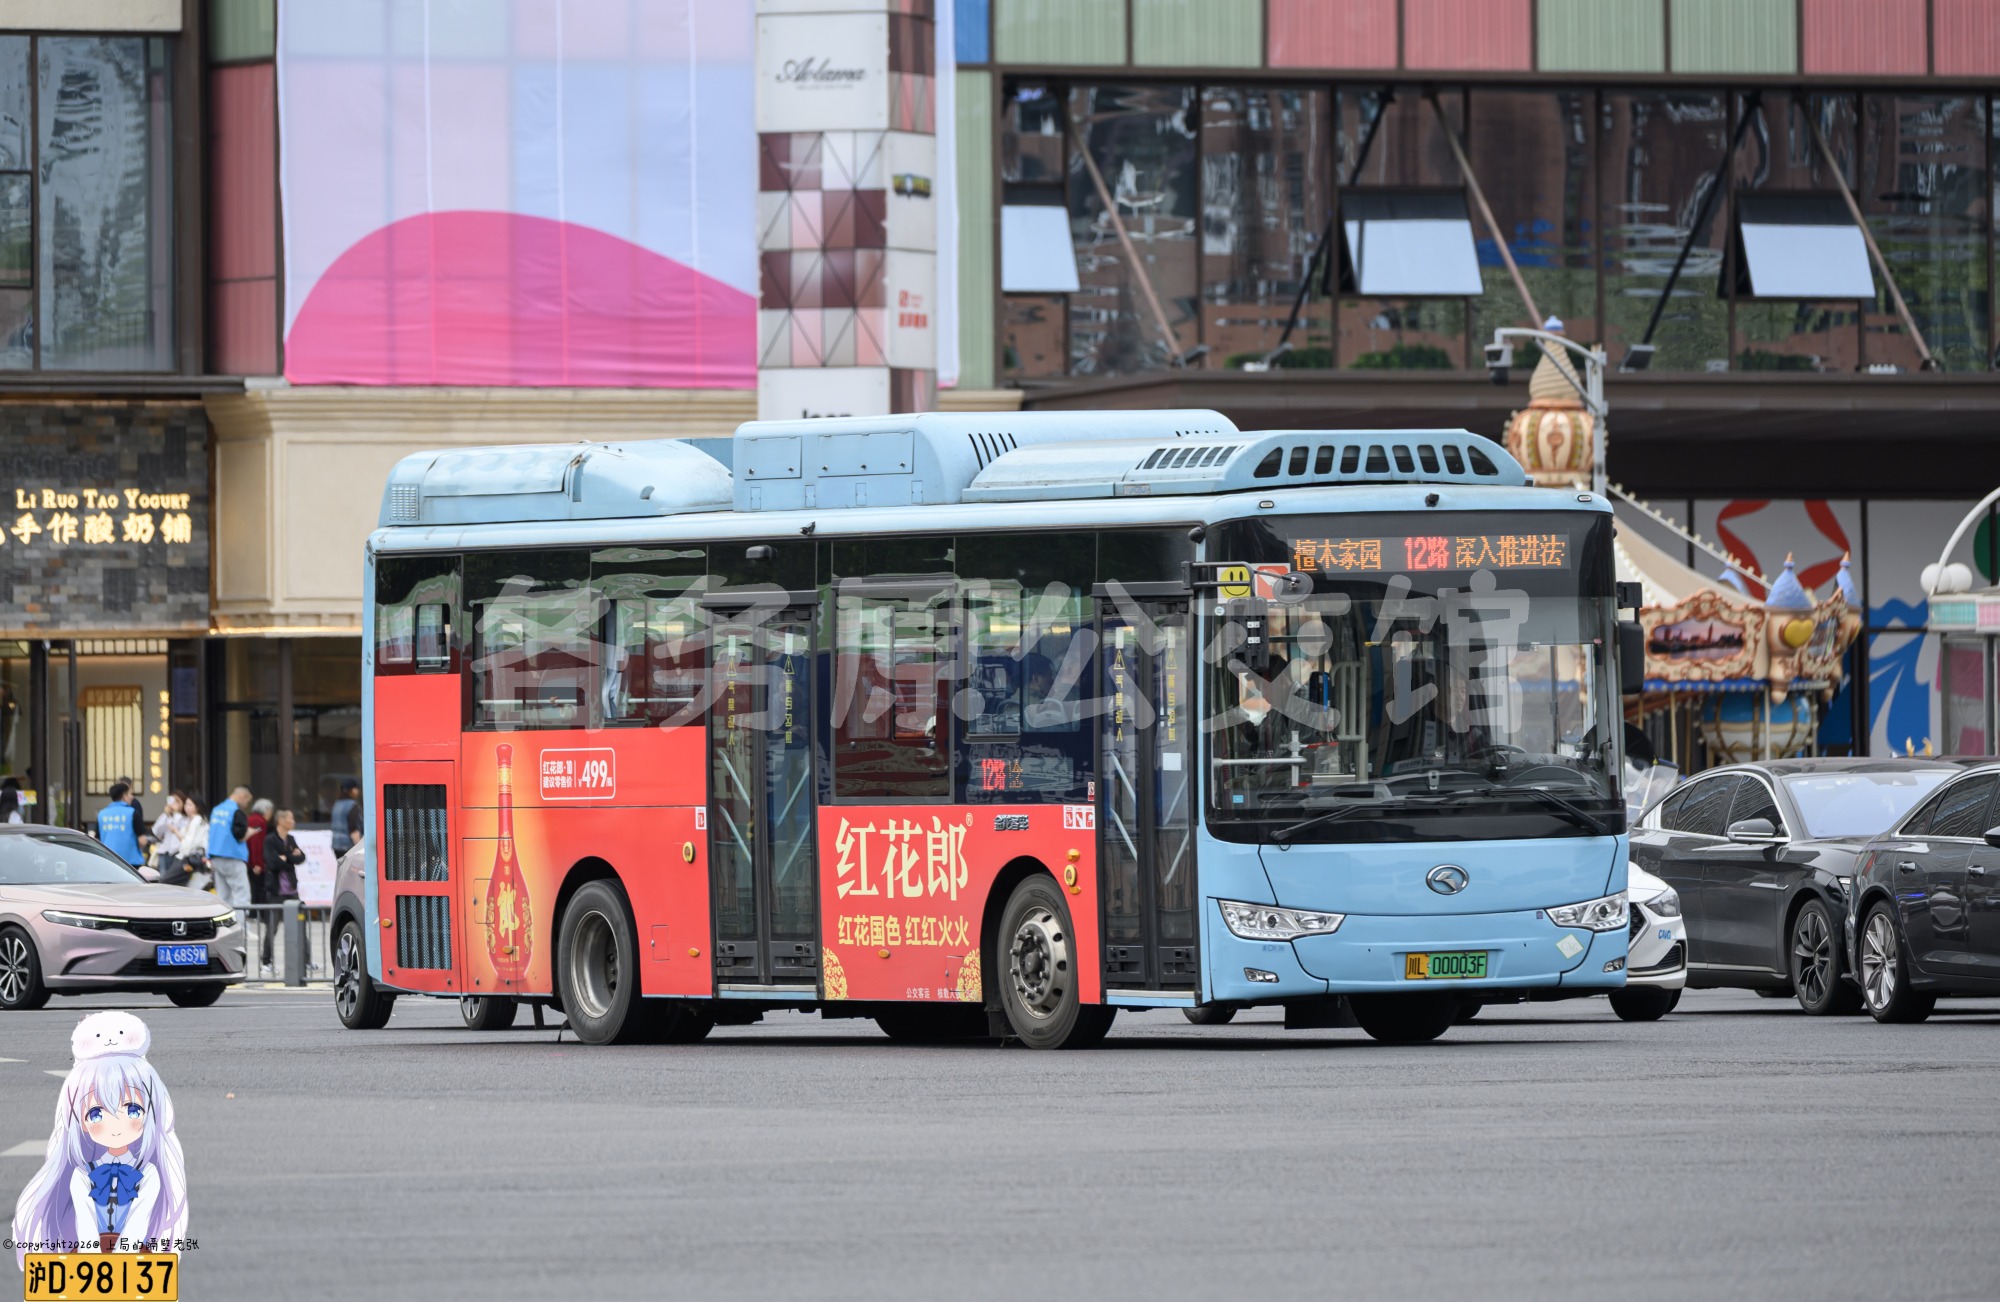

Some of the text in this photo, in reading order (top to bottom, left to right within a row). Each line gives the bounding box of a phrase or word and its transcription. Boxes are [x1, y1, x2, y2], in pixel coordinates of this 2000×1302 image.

[1294, 539, 1381, 571] 檀木家园
[1404, 537, 1450, 570] 12路
[835, 815, 969, 901] 红花郎
[838, 915, 970, 947] 红花国色 红红火火
[1658, 929, 1671, 939] CNG
